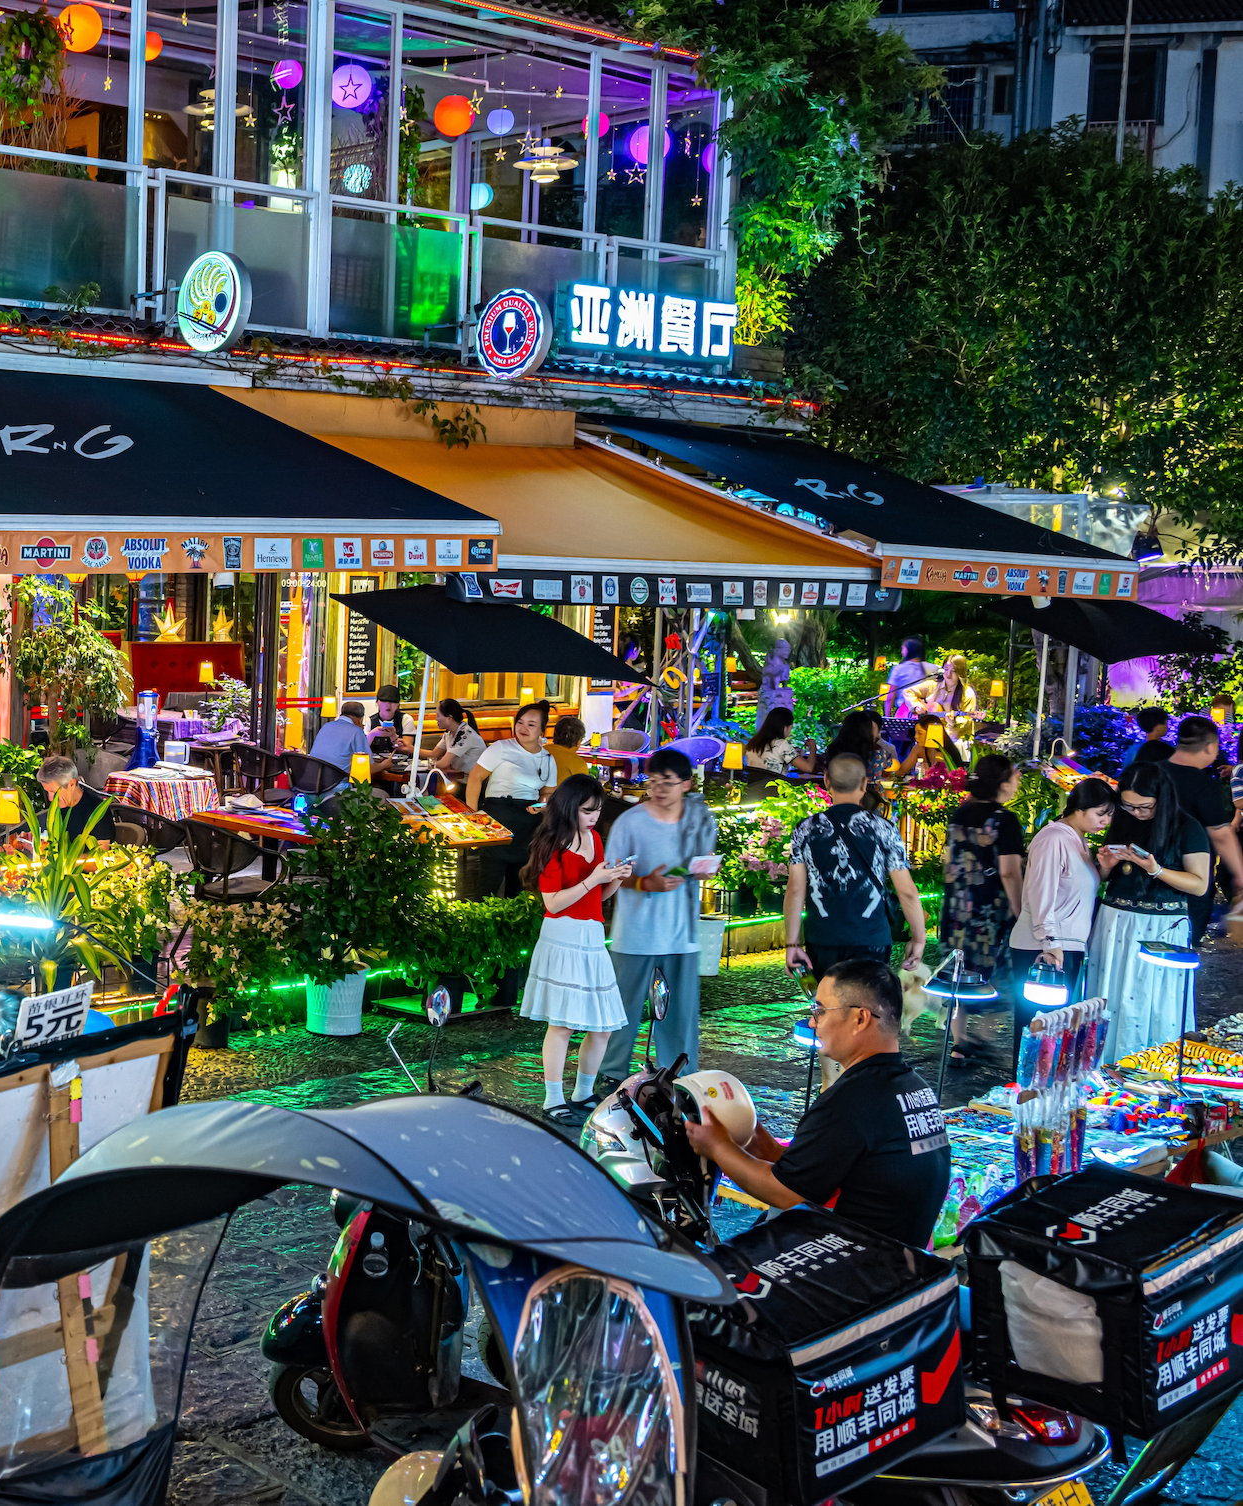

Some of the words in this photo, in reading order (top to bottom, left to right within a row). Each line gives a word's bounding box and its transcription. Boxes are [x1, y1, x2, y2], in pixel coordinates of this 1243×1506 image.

[484, 304, 502, 347] PREMIUM
[503, 299, 532, 318] QUALITY
[525, 320, 535, 347] WINE
[570, 284, 738, 357] 亚洲餐厅
[493, 356, 507, 365] SINCE
[123, 537, 167, 551] ABSOLUT
[181, 537, 210, 551] MALIBU
[470, 546, 491, 556] Corona
[23, 547, 70, 558] MARTINI
[257, 554, 289, 564] Hennessy
[408, 552, 425, 560] Duvel
[81, 554, 112, 569] BACARDI
[127, 556, 162, 570] VODKA
[954, 571, 979, 581] MARTINI
[1007, 568, 1030, 579] ABSOLUT
[281, 579, 327, 588] 09:00-24:00
[660, 585, 675, 595] 1664
[1007, 581, 1025, 592] VODKA
[28, 987, 88, 1016] 苗银耳环
[22, 1001, 84, 1041] 5元
[904, 1107, 945, 1139] 用顺丰同
[1069, 1187, 1154, 1229] 顺丰同城
[752, 1232, 854, 1280] 顺丰同城
[1155, 1326, 1227, 1390] 用顺丰同城
[815, 1387, 917, 1457] 用顺丰同城
